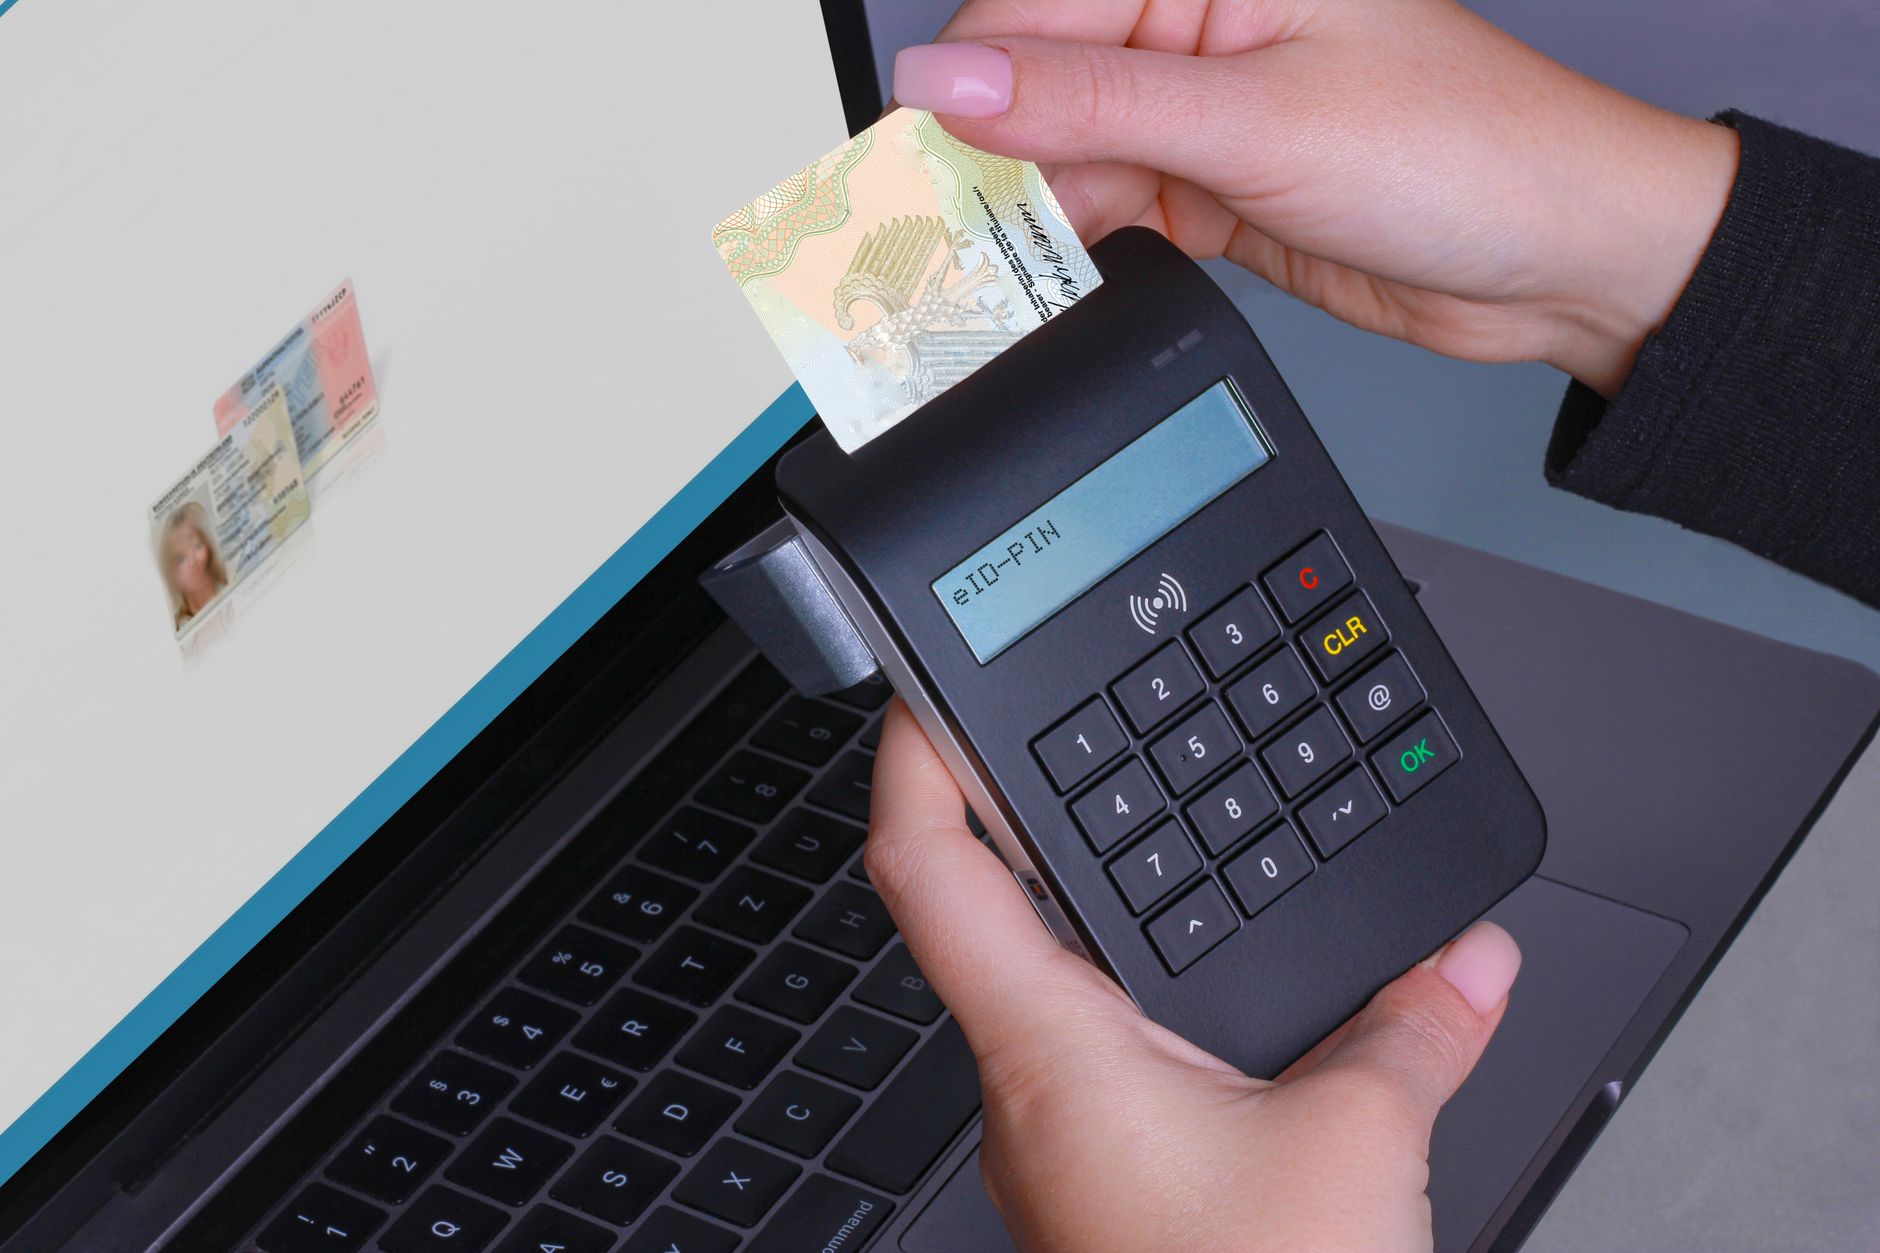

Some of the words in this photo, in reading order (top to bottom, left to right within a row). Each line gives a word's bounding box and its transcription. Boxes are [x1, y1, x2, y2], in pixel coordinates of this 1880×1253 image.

[988, 226, 1011, 260] Inhabers
[1000, 232, 1008, 242] la
[1005, 240, 1014, 252] de
[1012, 251, 1036, 289] Signature
[1008, 259, 1041, 311] Inhaberin/des
[1035, 293, 1053, 318] bearer
[1037, 310, 1048, 323] der
[953, 519, 1061, 606] eID-PIN
[1299, 567, 1319, 590] C
[1225, 623, 1243, 645] 3
[1323, 616, 1368, 655] CLR
[1151, 677, 1171, 701] 2
[1262, 683, 1280, 705] 6
[1368, 684, 1392, 711] @
[809, 727, 831, 740] 9
[1076, 733, 1092, 754] 1
[1187, 735, 1206, 759] 5
[1297, 742, 1315, 764] 9
[1400, 738, 1435, 772] OK
[755, 783, 777, 797] 8
[1115, 794, 1130, 815] 4
[1224, 797, 1242, 819] 8
[697, 839, 718, 854] 7
[795, 835, 821, 852] U
[1146, 852, 1163, 877] 7
[1260, 856, 1278, 879] 0
[640, 900, 663, 915] 6
[739, 895, 765, 912] Z
[839, 911, 866, 928] H
[552, 951, 573, 965] %
[680, 955, 705, 970] T
[579, 961, 604, 977] 5
[784, 974, 809, 989] G
[900, 975, 926, 992] B
[522, 1024, 544, 1040] 4
[621, 1020, 648, 1037] R
[724, 1037, 745, 1054] F
[842, 1037, 867, 1052] V
[456, 1089, 481, 1105] 3
[560, 1084, 587, 1102] E
[663, 1103, 689, 1121] D
[785, 1104, 811, 1121] C
[391, 1156, 417, 1173] 2
[492, 1147, 524, 1169] W
[602, 1170, 628, 1188] S
[722, 1171, 751, 1191] X
[326, 1226, 348, 1237] 1
[431, 1220, 461, 1238] Q
